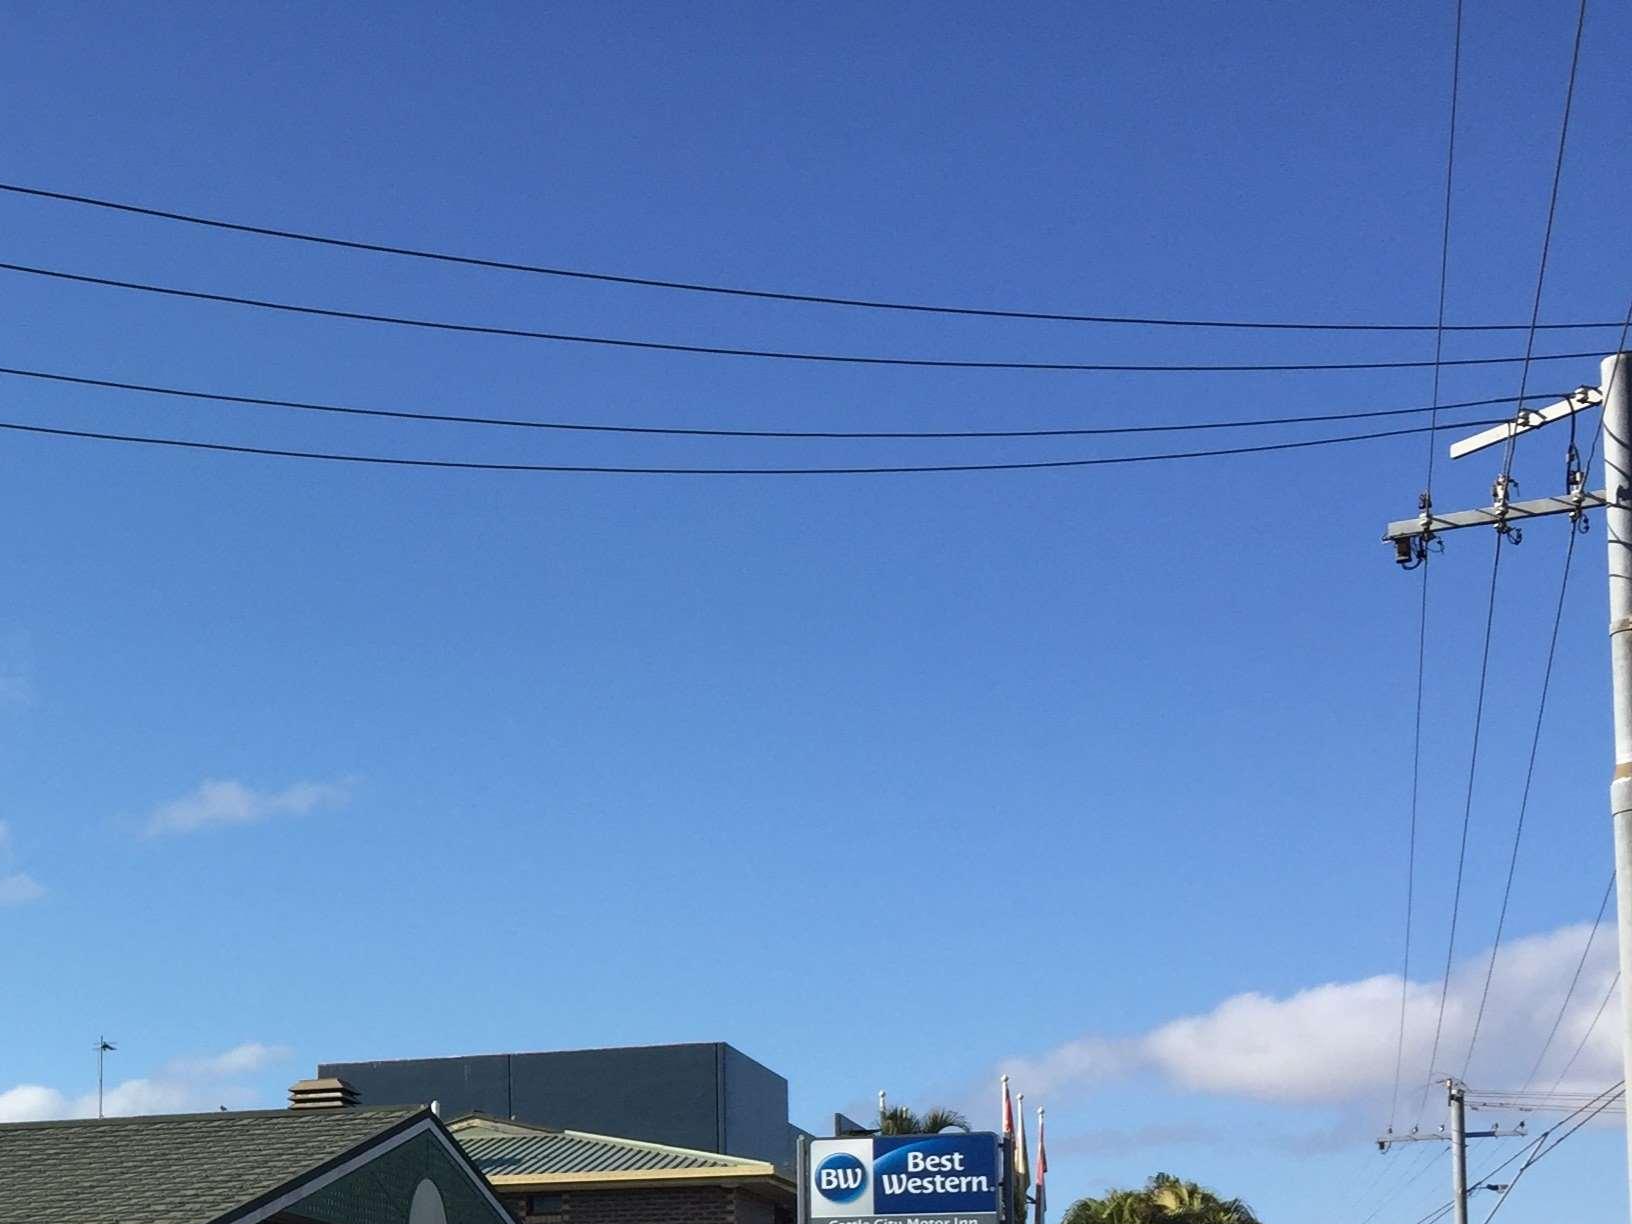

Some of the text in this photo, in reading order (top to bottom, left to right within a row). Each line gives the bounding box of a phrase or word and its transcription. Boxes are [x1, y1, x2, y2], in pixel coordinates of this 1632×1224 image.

[907, 1151, 965, 1172] Best
[820, 1168, 862, 1190] BW
[882, 1174, 989, 1195] Western
